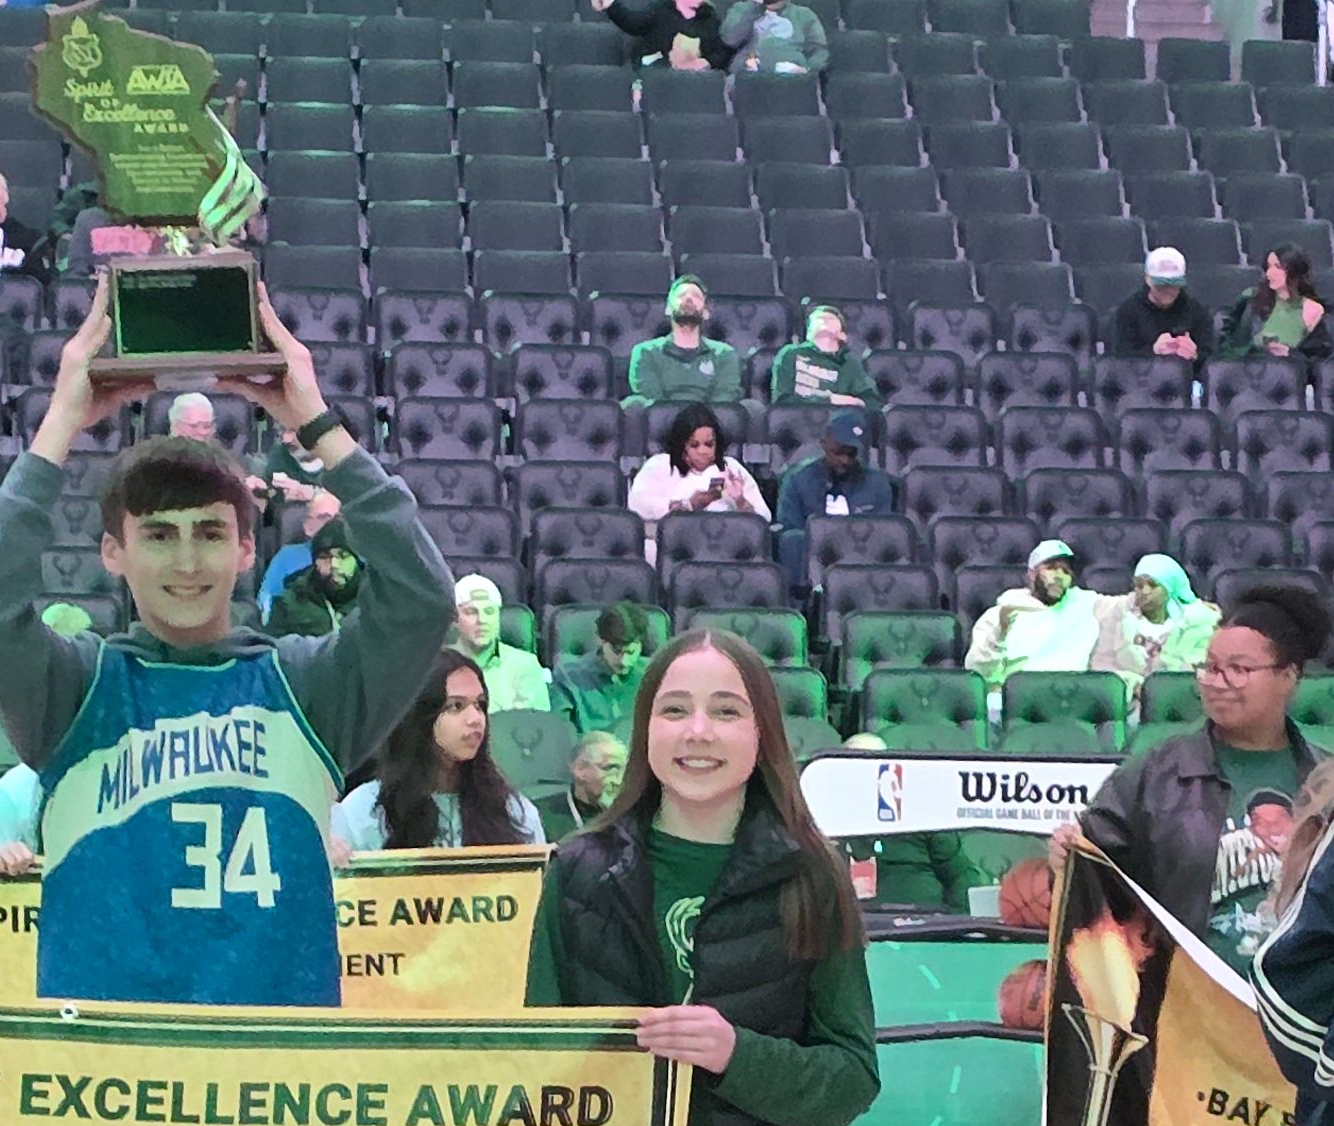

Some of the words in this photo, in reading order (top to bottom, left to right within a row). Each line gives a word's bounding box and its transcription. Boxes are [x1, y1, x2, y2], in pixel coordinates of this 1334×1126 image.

[97, 719, 270, 815] MILWAUKEE
[958, 771, 1092, 805] Wilson
[170, 802, 282, 910] 34
[389, 894, 518, 926] AWARD
[19, 1073, 389, 1126] EXCELLENCE
